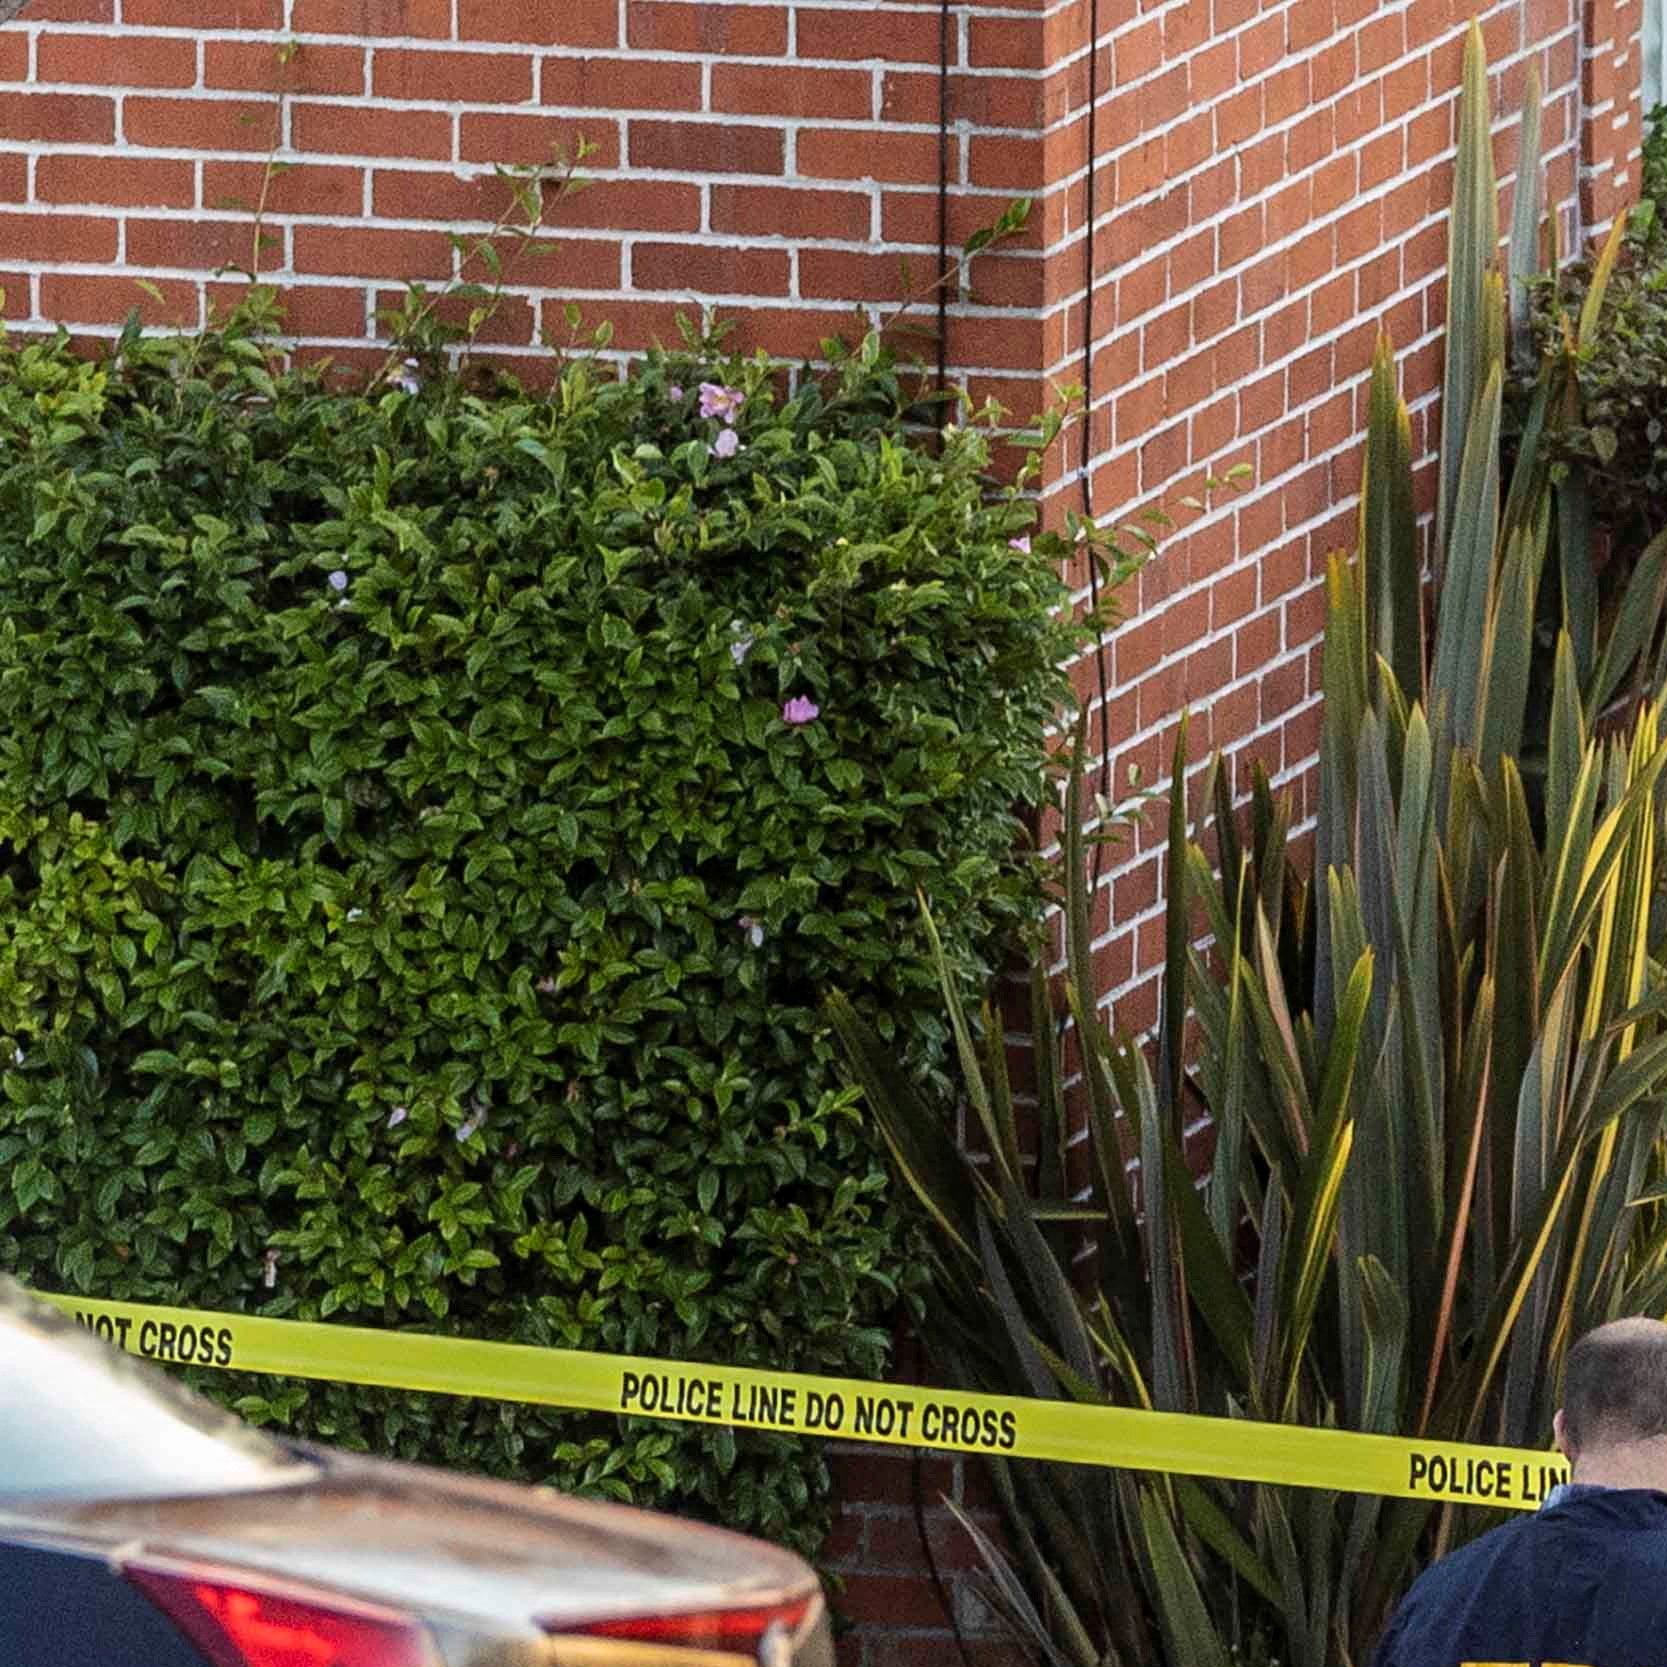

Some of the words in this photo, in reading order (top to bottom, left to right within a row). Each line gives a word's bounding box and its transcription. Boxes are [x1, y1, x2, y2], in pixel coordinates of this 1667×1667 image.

[139, 1320, 233, 1366] CROSS
[620, 1371, 724, 1419] POLICE
[732, 1384, 797, 1426] LINE
[805, 1391, 845, 1432] DO
[854, 1396, 915, 1440] NOT
[921, 1402, 1018, 1449] CROSS
[1408, 1453, 1512, 1499] POLICE
[1521, 1463, 1568, 1502] LIN
